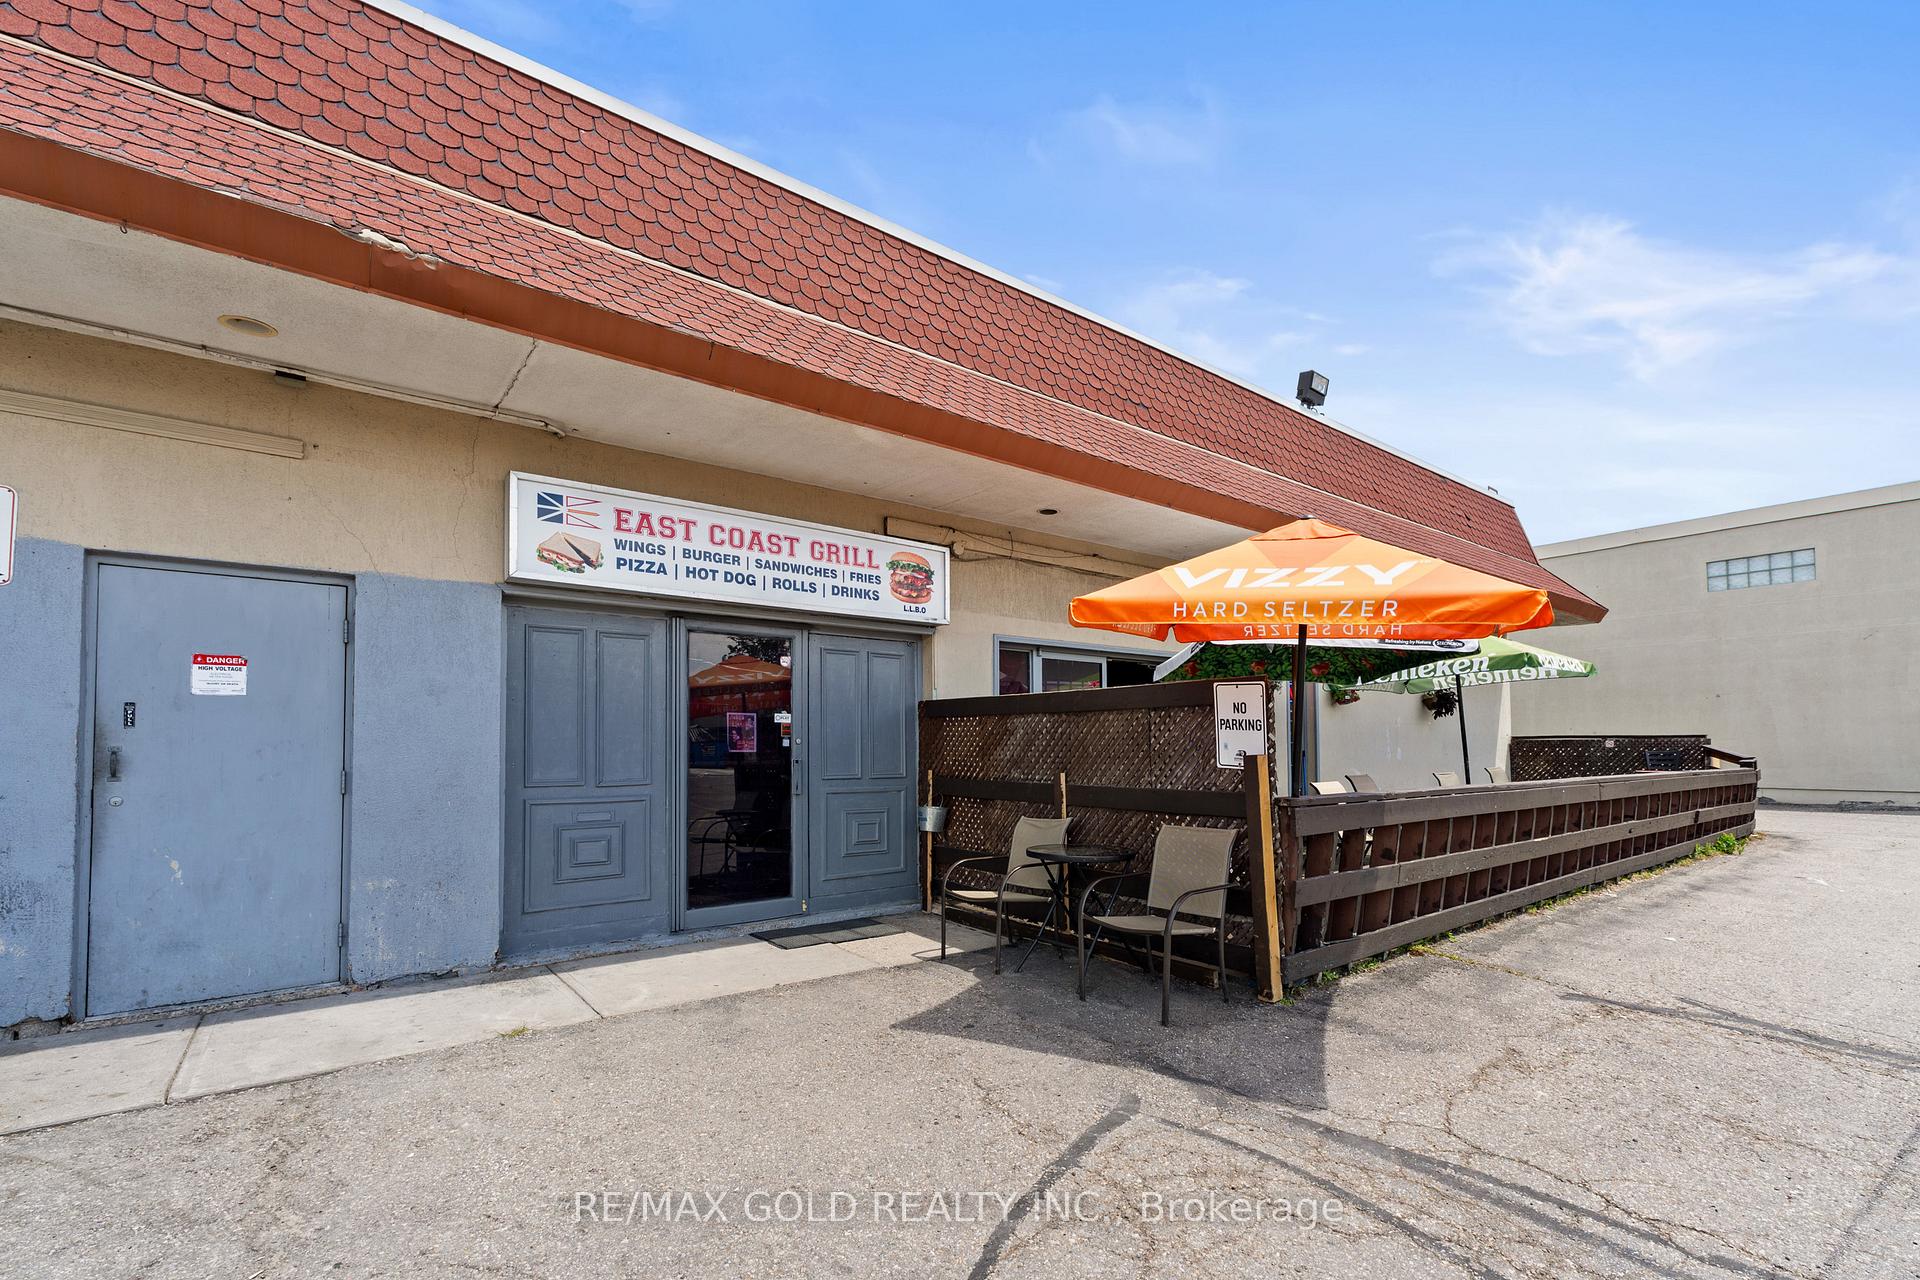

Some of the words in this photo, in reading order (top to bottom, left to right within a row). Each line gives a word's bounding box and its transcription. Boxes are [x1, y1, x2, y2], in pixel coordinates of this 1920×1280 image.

[613, 507, 698, 542] EAST
[708, 523, 800, 558] COAST
[810, 539, 880, 570] GRILL
[614, 538, 666, 556] WINGS
[682, 548, 741, 566] BURGER
[754, 558, 838, 579] SANDWICHES
[850, 571, 882, 585] FRIES
[616, 557, 668, 576] PIZZA
[685, 566, 719, 581] HOT
[723, 571, 757, 586] DOG
[772, 577, 817, 594] ROLLS
[831, 585, 880, 601] DRINKS
[1174, 560, 1420, 589] VIZZY
[1173, 601, 1248, 618] HARD
[1263, 599, 1399, 618] SELTZER
[206, 656, 246, 665] DANGER
[1232, 702, 1247, 715] NO
[1219, 718, 1262, 732] PARKING
